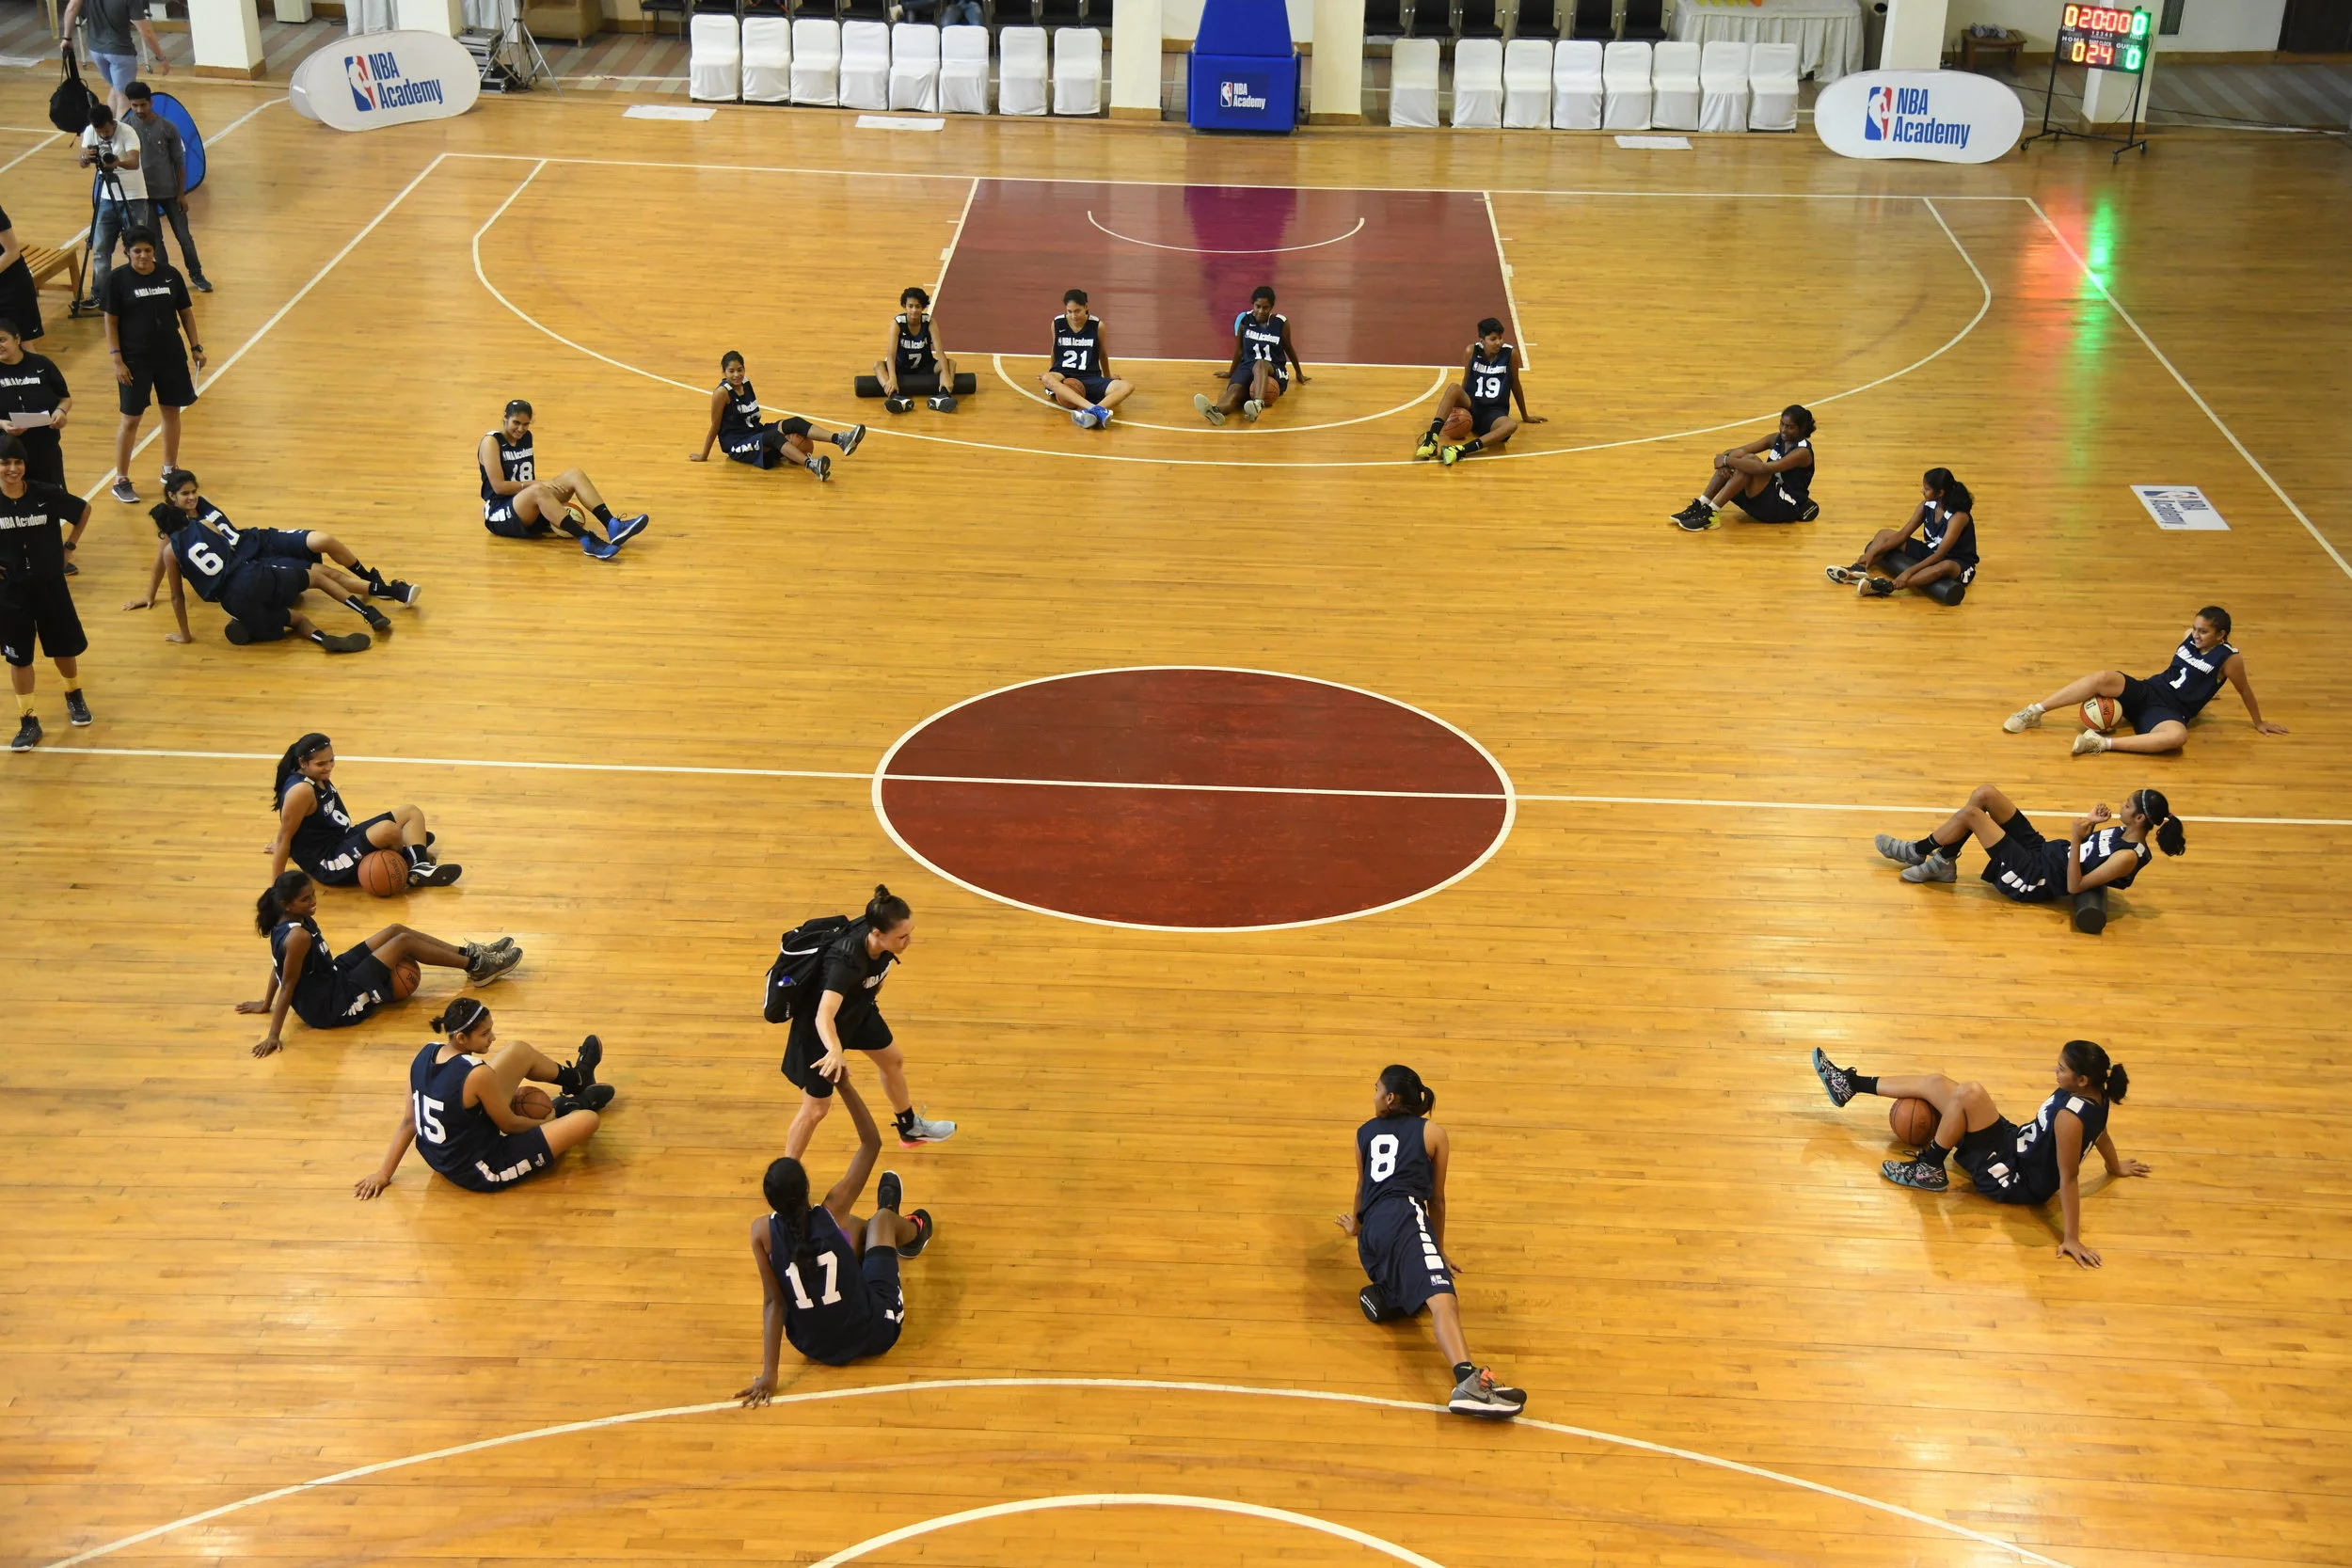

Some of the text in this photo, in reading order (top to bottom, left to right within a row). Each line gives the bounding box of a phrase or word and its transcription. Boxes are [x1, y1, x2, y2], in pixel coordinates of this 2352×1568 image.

[2064, 5, 2149, 37] 0 20:00 0
[368, 52, 401, 81] NBA
[2086, 44, 2114, 66] 24
[376, 78, 444, 110] Academy
[1233, 83, 1248, 96] NBA
[1232, 95, 1266, 110] Academy
[1896, 87, 1929, 116] NBA
[1892, 116, 1971, 150] Academy
[908, 353, 922, 370] 7
[1061, 350, 1089, 371] 21
[1252, 342, 1273, 362] 11
[1474, 376, 1501, 399] 19
[510, 461, 533, 482] 18
[0, 514, 48, 531] NBA Academy
[188, 542, 224, 577] 6
[2169, 667, 2187, 689] 1
[412, 1089, 447, 1145] 15
[1370, 1133, 1400, 1183] 8
[785, 1250, 842, 1310] 17
